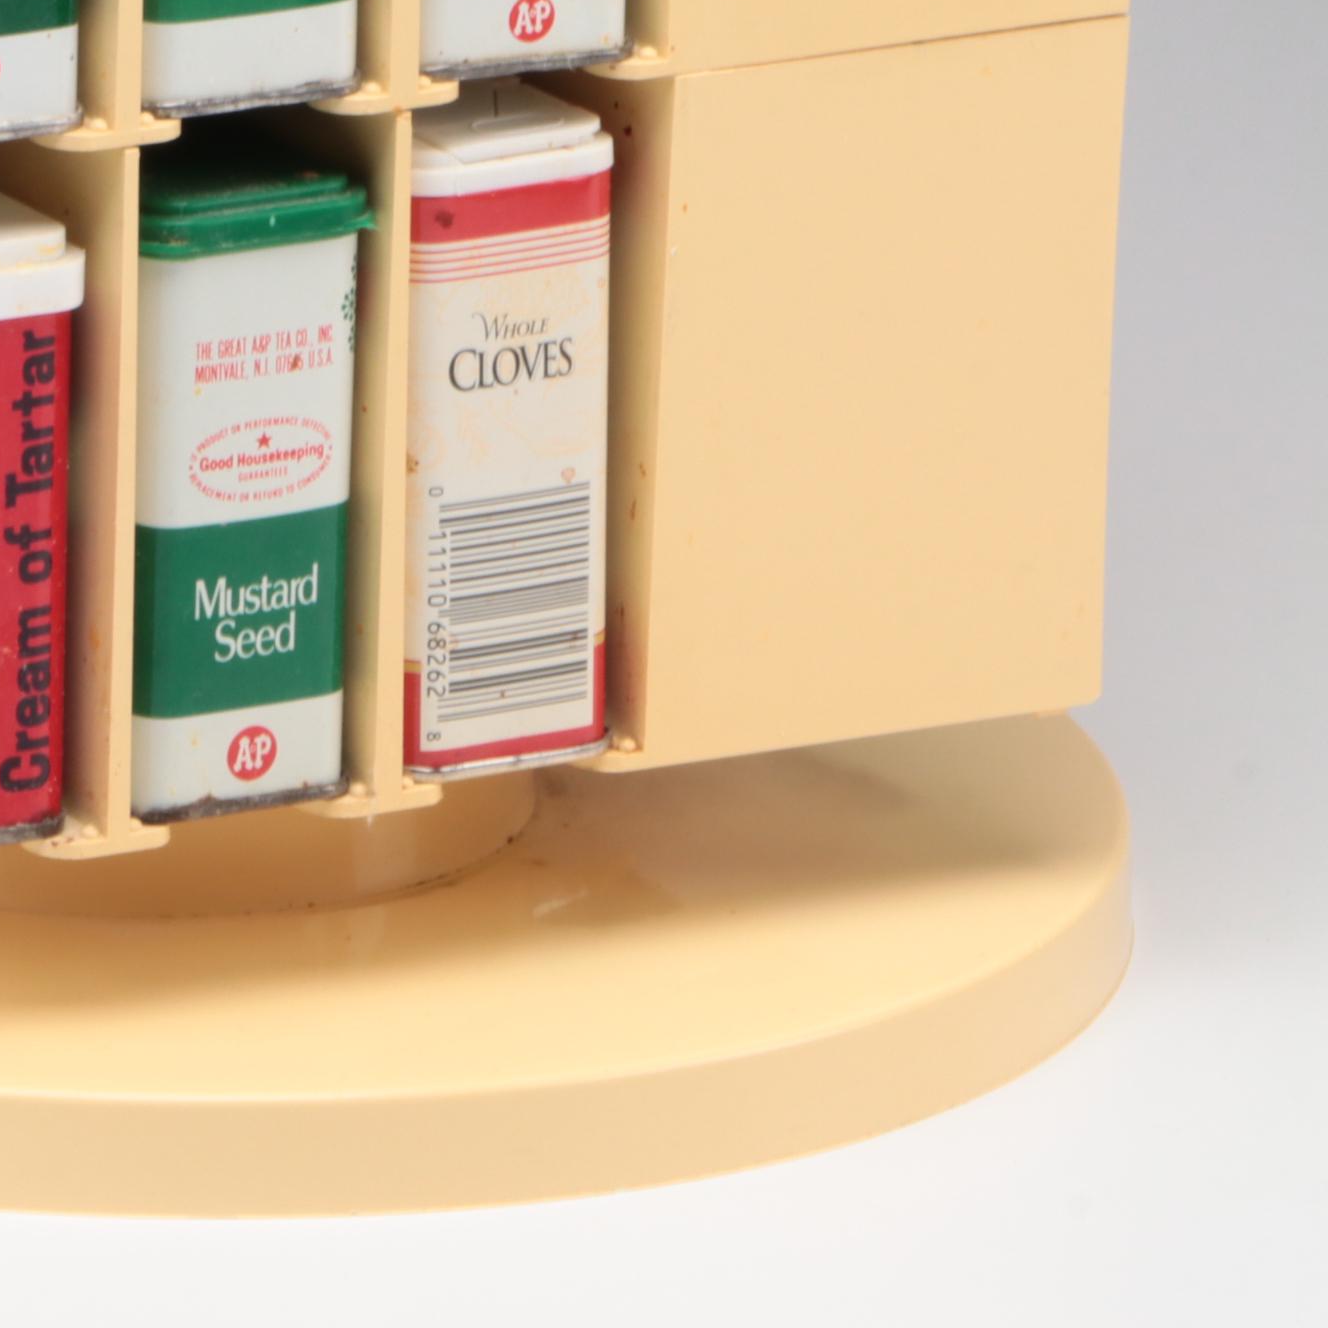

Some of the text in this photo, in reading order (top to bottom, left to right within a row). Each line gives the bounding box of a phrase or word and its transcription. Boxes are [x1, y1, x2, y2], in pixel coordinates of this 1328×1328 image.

[196, 342, 213, 361] THE
[217, 336, 247, 358] GREAT
[276, 330, 291, 351] TEA
[275, 352, 304, 375] 0765
[448, 337, 573, 392] CLOVES
[6, 329, 56, 509] Tartar
[199, 442, 325, 472] Good Housekeeping
[4, 527, 54, 584] of
[194, 561, 319, 621] Mustard
[214, 608, 296, 663] Seed
